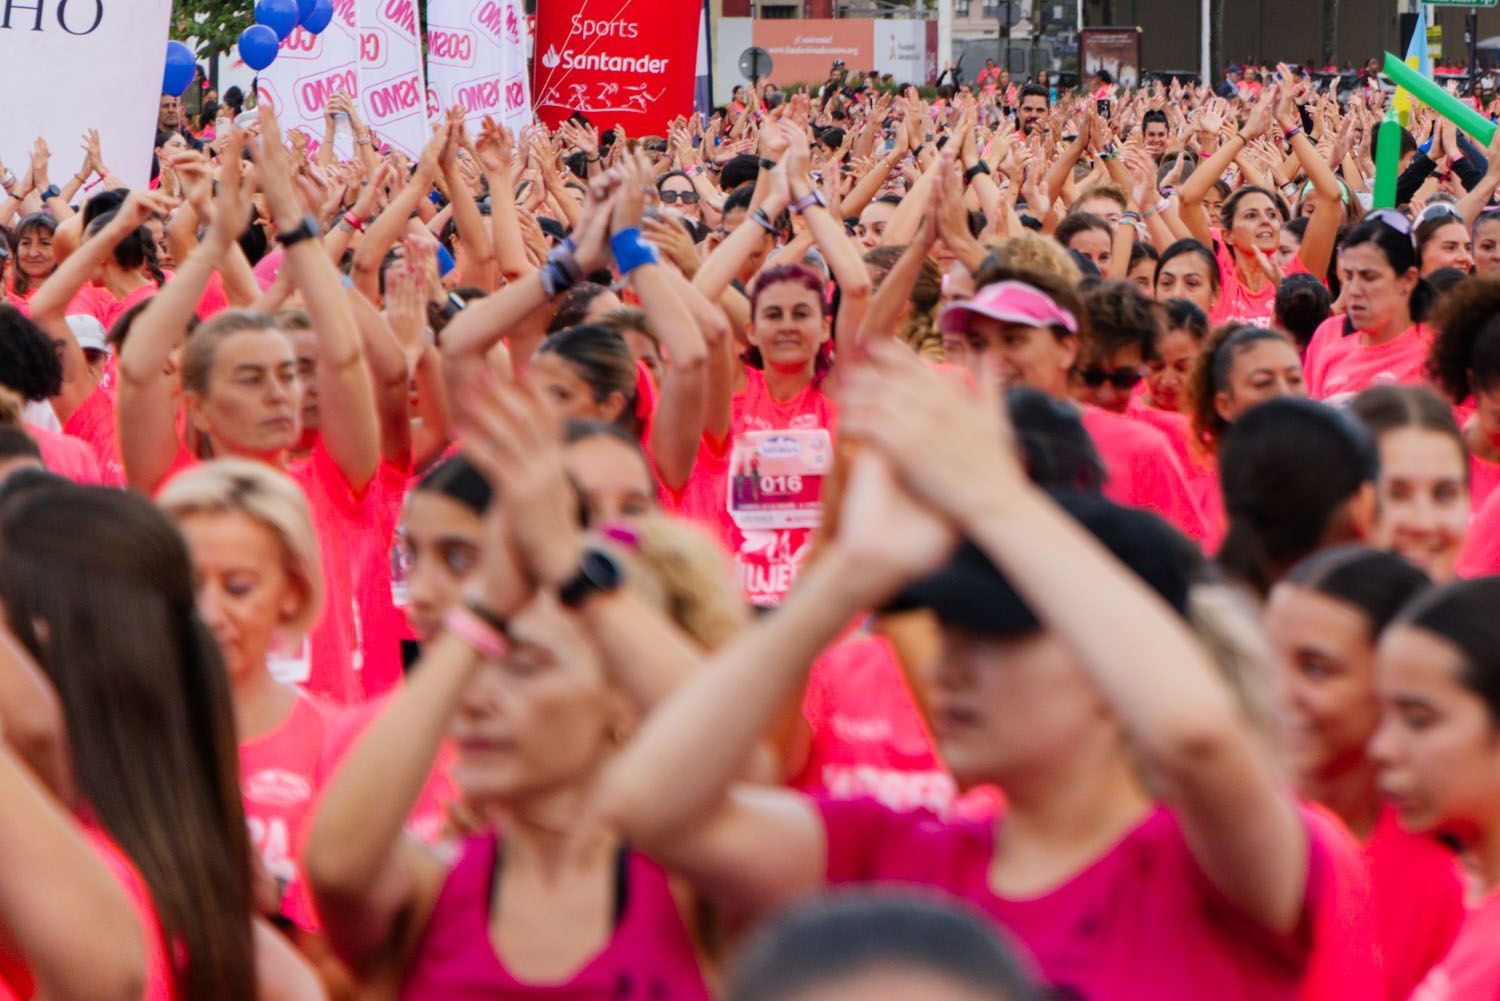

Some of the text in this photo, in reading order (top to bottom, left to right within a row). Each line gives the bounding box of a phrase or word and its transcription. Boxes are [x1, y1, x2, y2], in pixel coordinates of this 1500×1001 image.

[571, 14, 639, 39] Sports
[562, 50, 670, 74] Santander
[760, 475, 803, 493] 016
